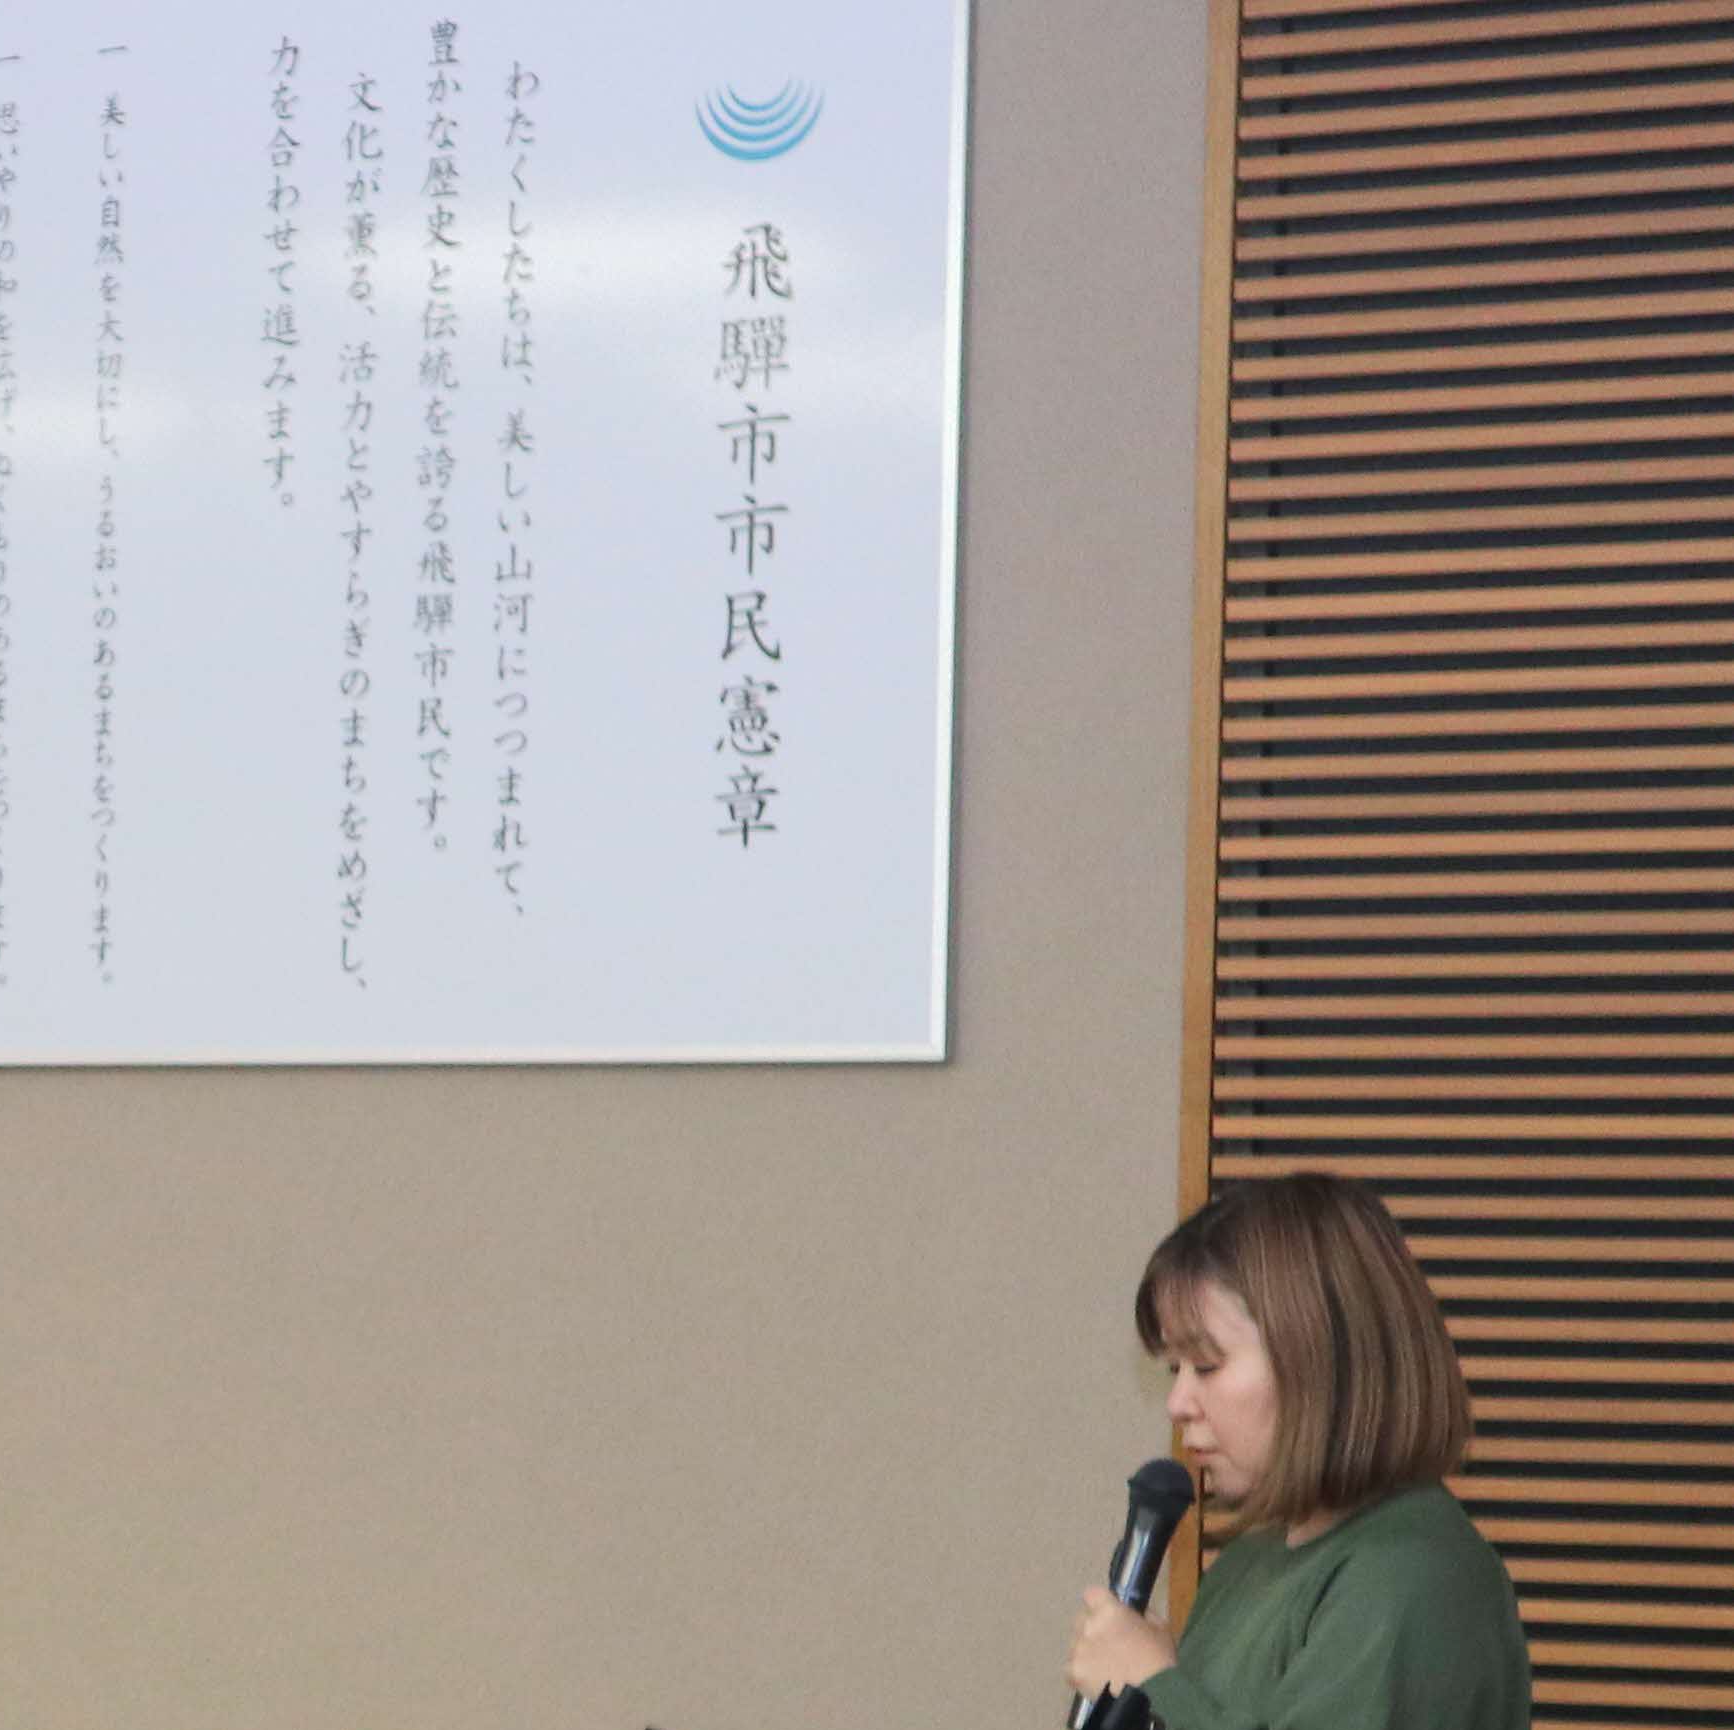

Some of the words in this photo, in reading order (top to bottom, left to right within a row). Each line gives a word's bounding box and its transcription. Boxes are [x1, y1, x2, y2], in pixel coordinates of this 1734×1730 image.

[260, 36, 301, 507] 力を合わせて進みます。
[336, 71, 384, 989] 文化が薫る、活力とやすらぎのまちをめざし、
[492, 60, 540, 916] わたくしたちは、美しい山河につつまれて、
